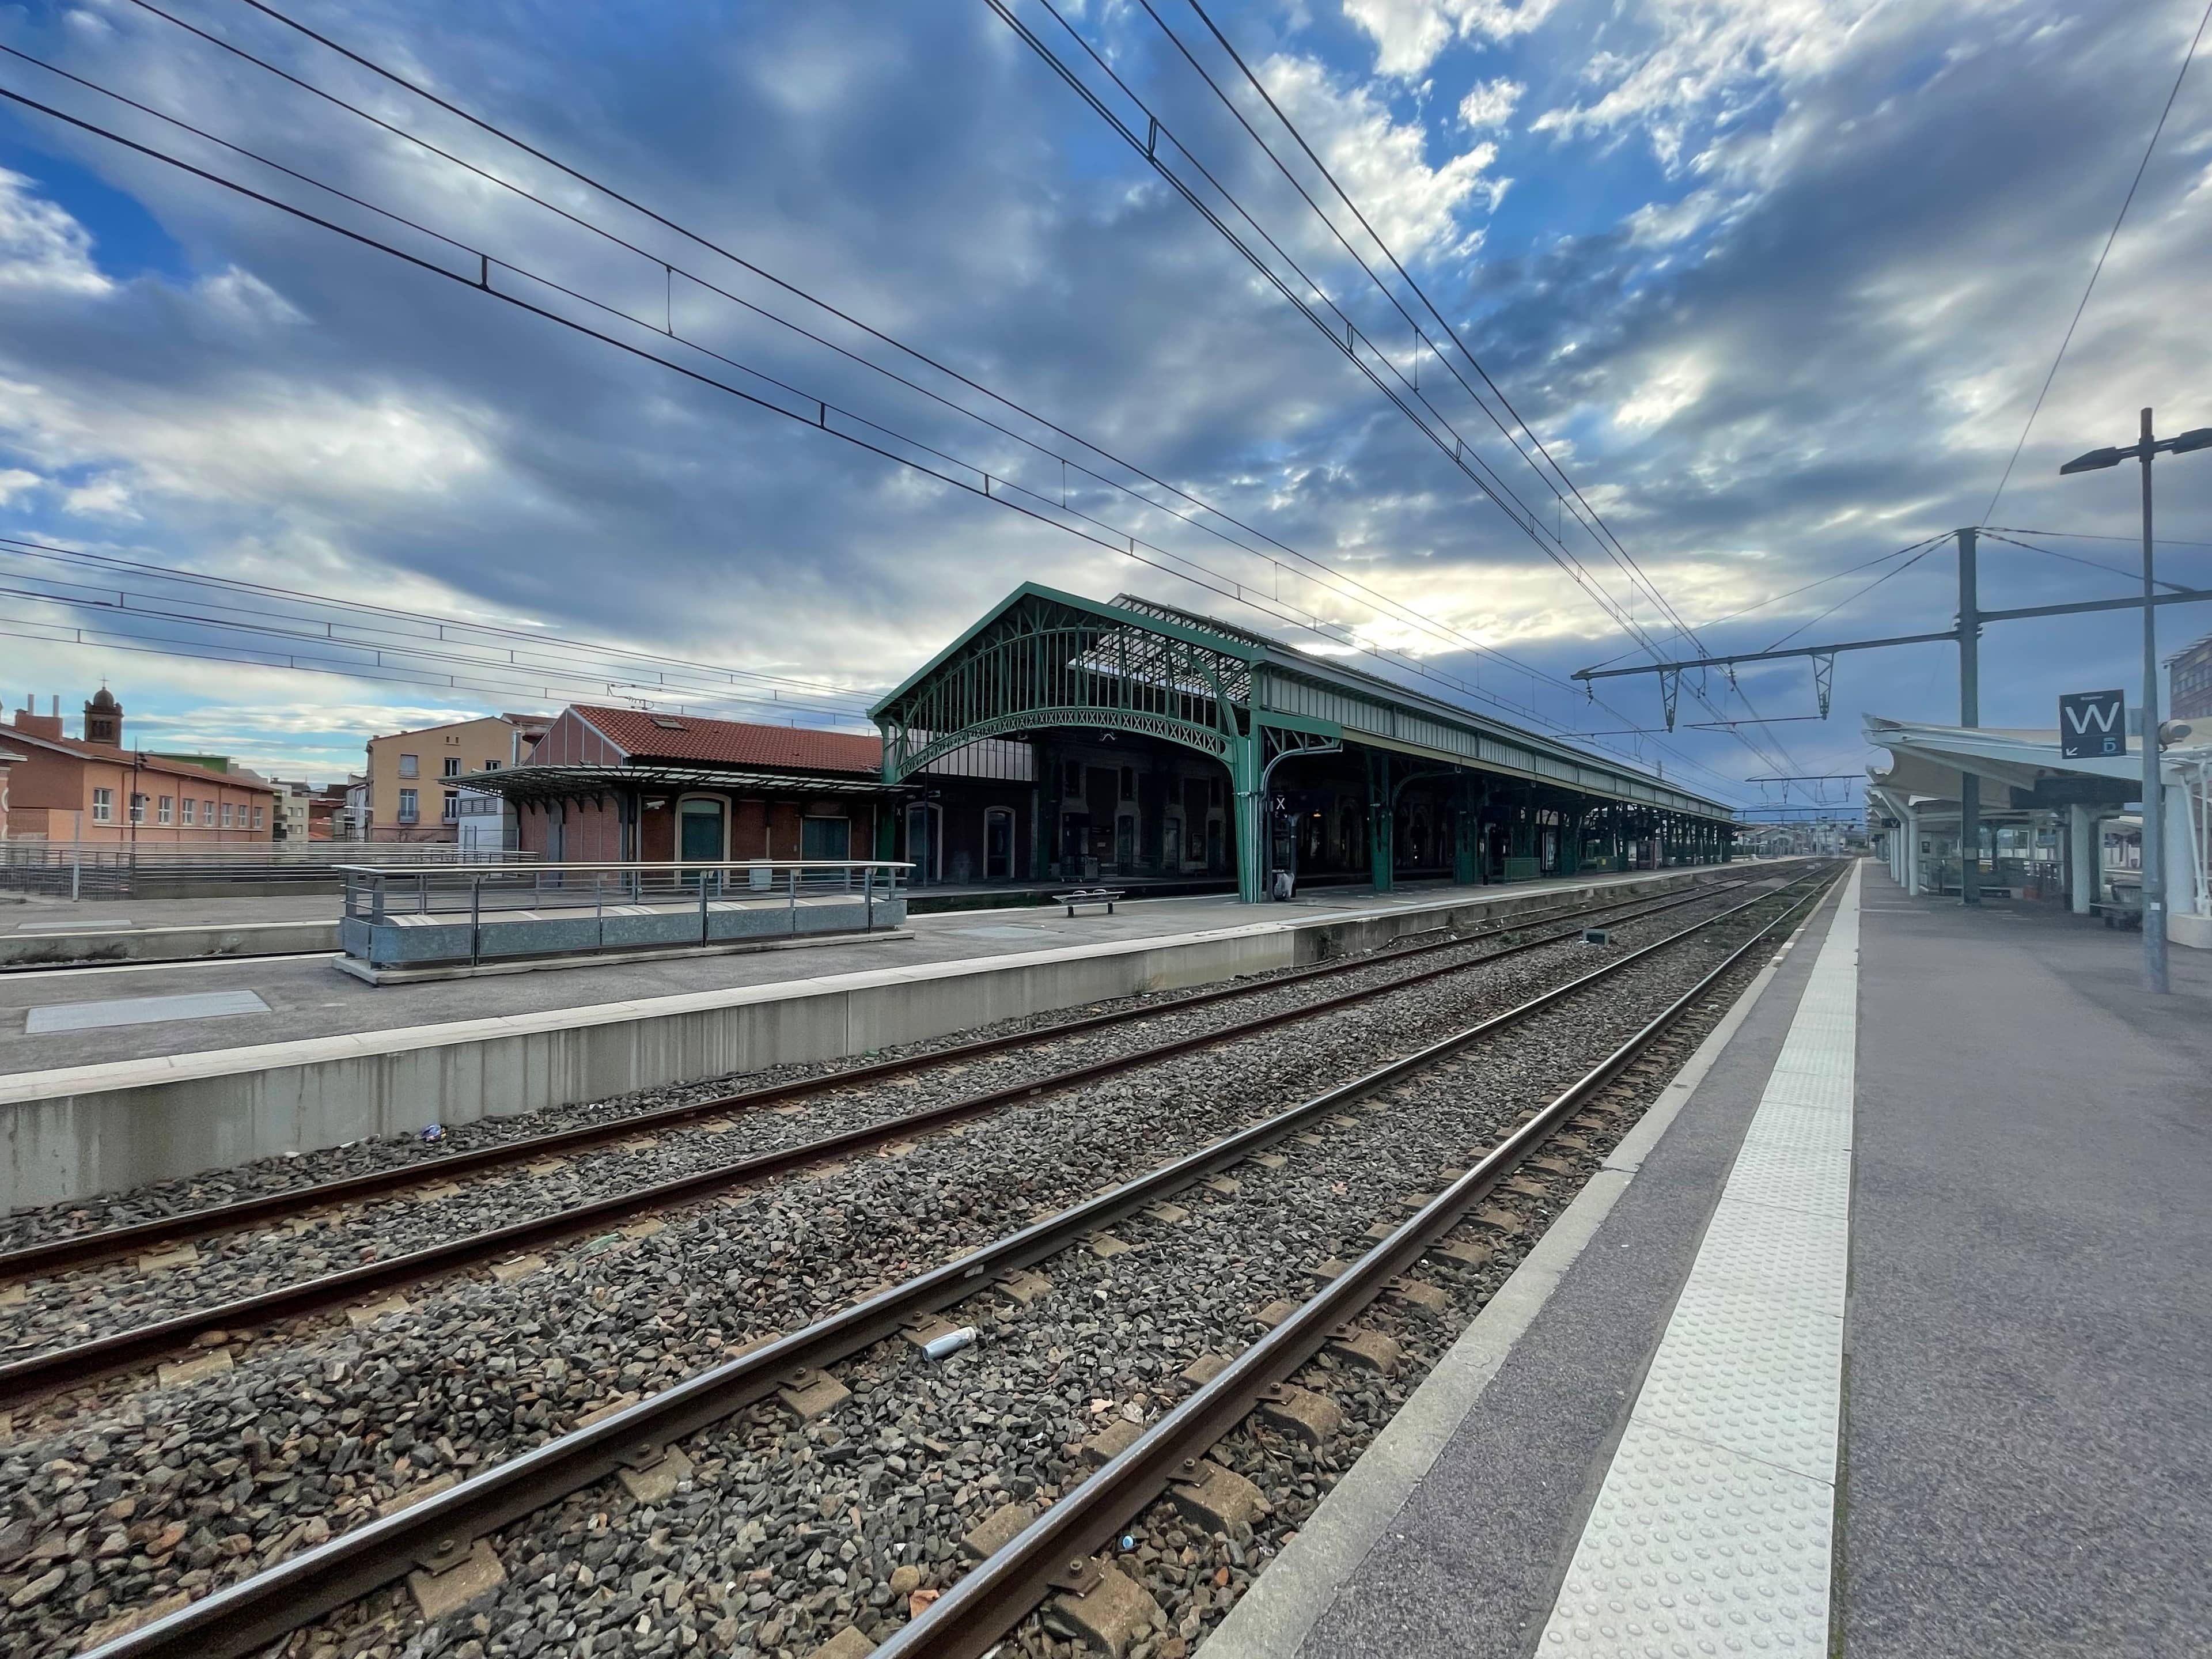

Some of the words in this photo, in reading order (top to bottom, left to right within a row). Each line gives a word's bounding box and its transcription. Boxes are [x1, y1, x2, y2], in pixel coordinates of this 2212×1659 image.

[2065, 702, 2120, 734] W
[2103, 742, 2116, 752] D
[1277, 798, 1285, 810] X
